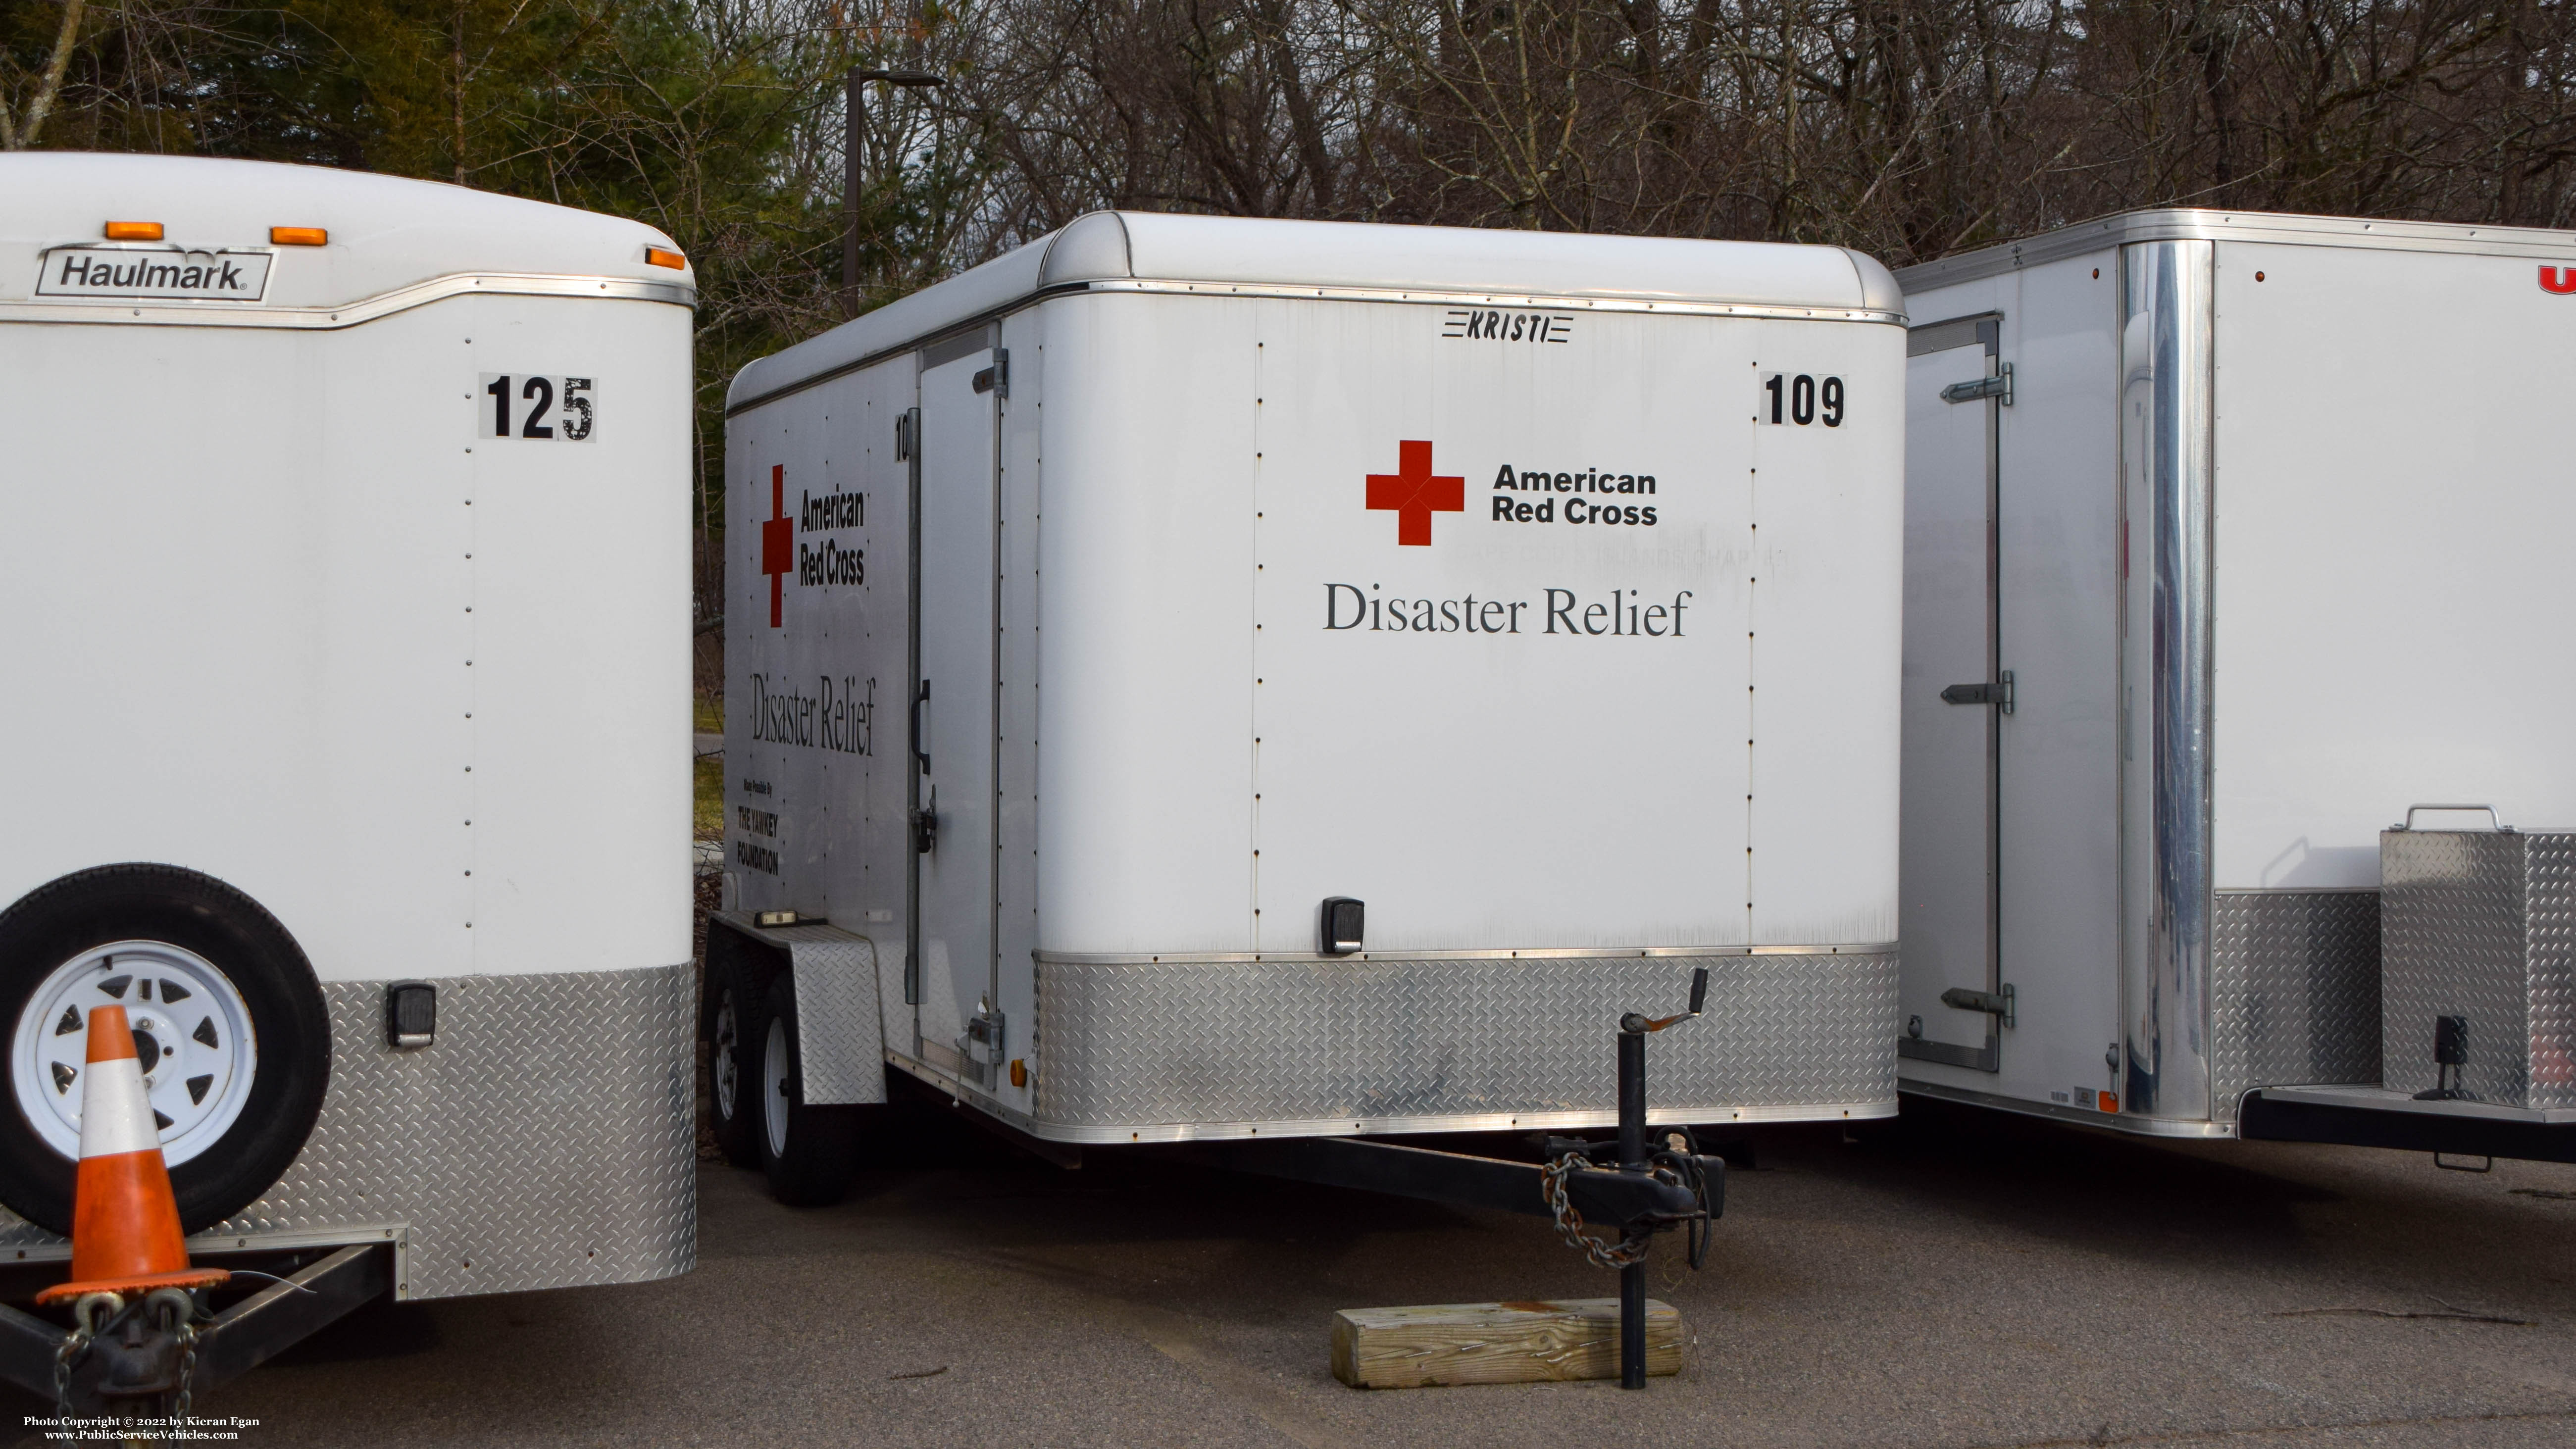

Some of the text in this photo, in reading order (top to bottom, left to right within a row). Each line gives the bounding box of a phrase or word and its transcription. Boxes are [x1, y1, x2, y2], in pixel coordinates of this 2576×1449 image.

[1466, 310, 1549, 343] KRISTI
[488, 375, 592, 441] 125
[1766, 374, 1844, 428] 109
[1493, 464, 1656, 497] American
[801, 483, 864, 533] American
[1492, 496, 1658, 526] Red Cross
[800, 538, 864, 587] Red Cross
[1322, 583, 1693, 637] Disaster Relief
[752, 671, 876, 757] Disaster Relief
[738, 805, 778, 838] THE YAWKEY
[737, 841, 778, 876] FOUNDATION
